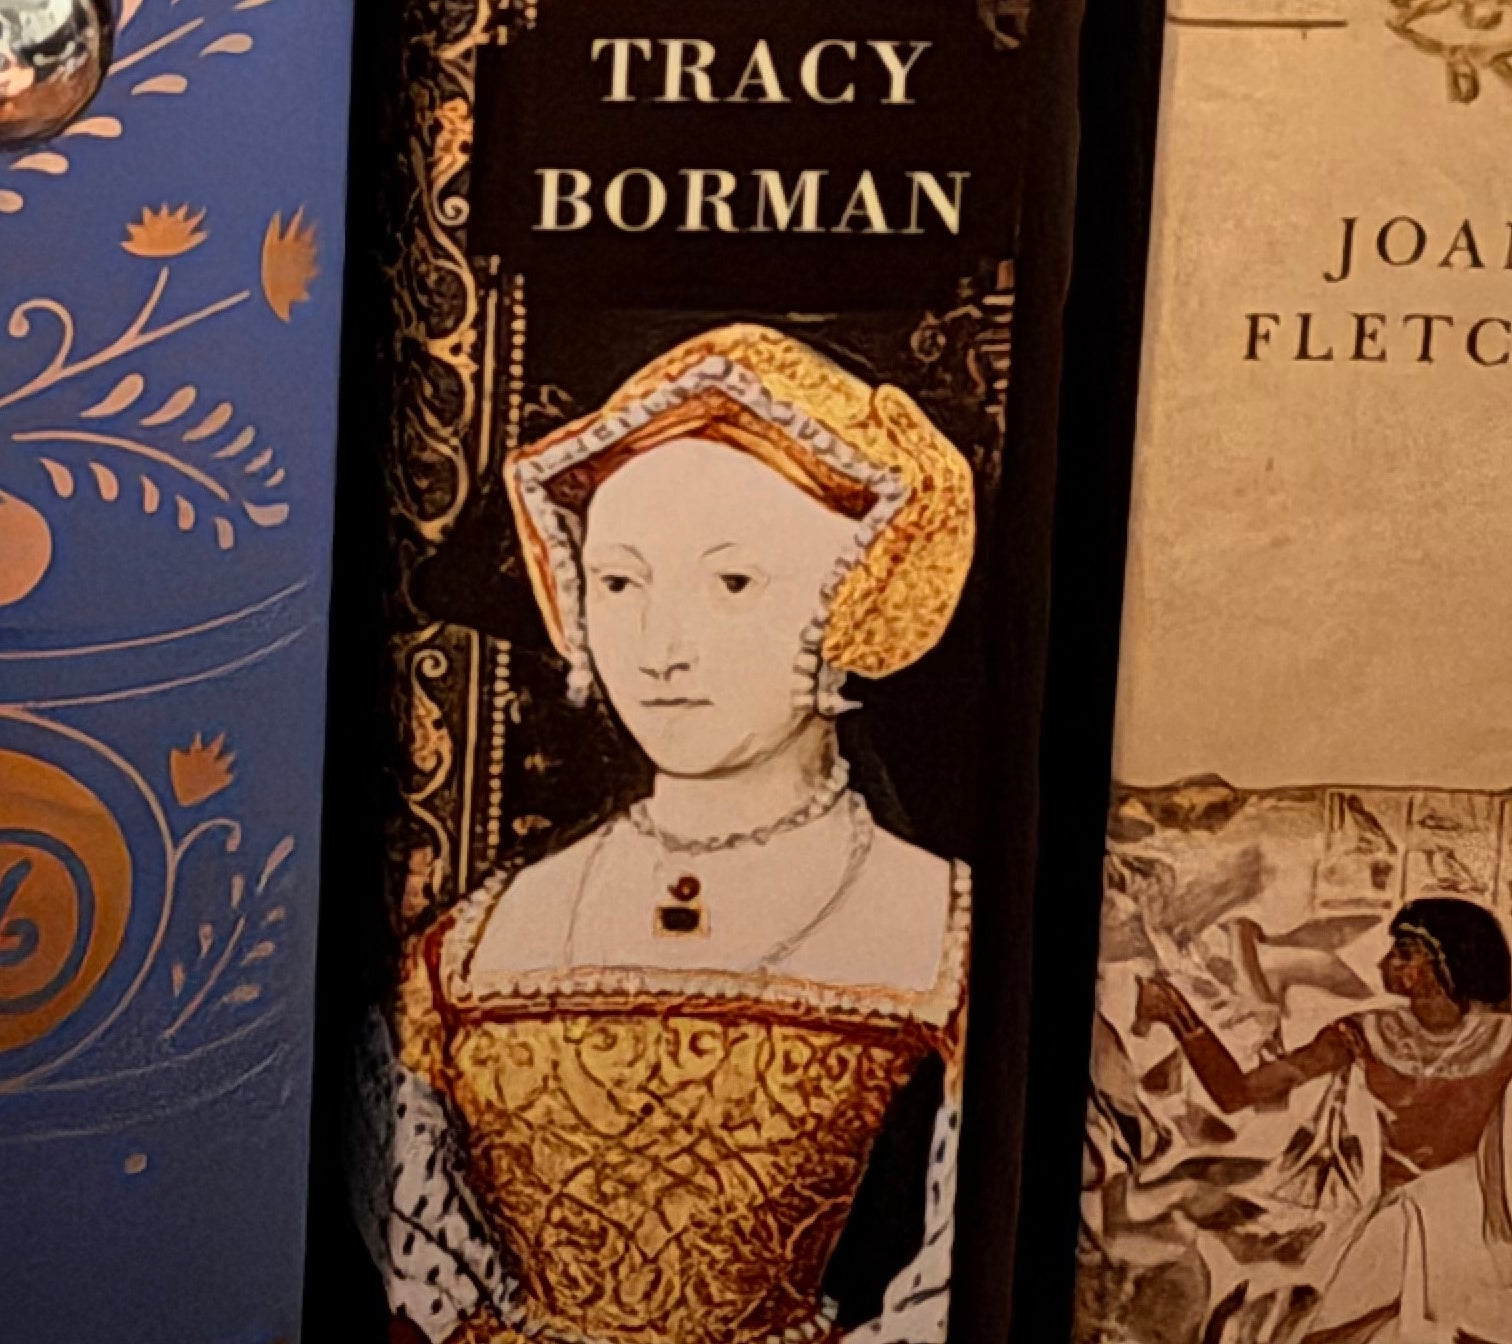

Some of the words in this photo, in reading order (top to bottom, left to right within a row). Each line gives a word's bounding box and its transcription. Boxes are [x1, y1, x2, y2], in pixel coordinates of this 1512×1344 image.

[590, 38, 932, 104] TRACY
[532, 168, 971, 236] BORMAN
[1322, 216, 1512, 283] JOA
[1243, 312, 1512, 367] FLETC
